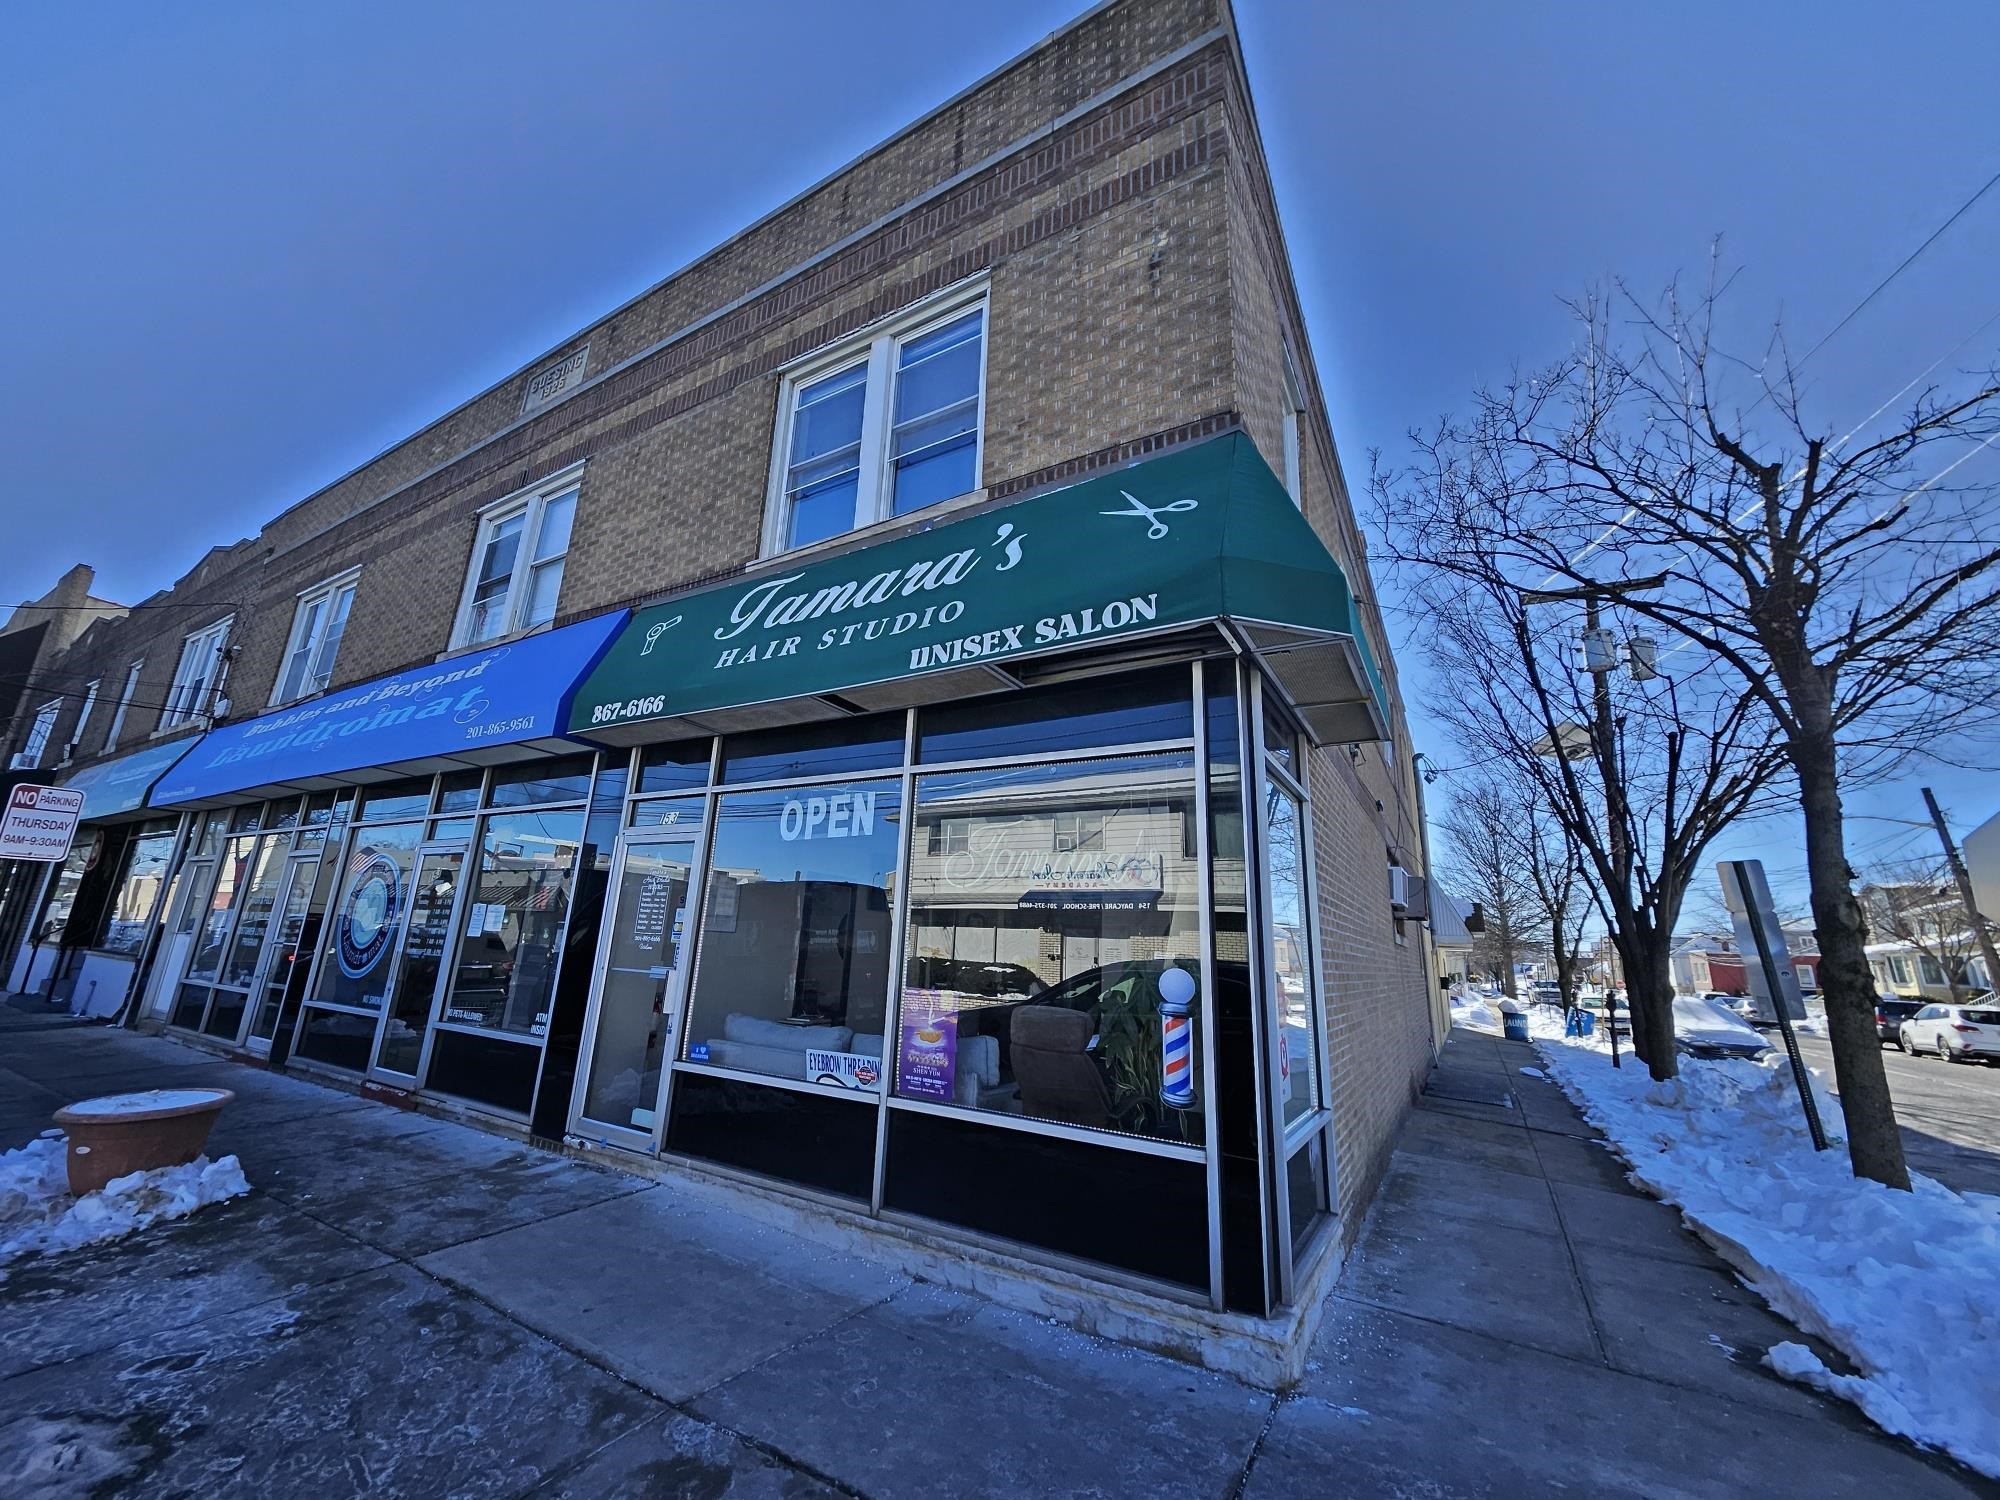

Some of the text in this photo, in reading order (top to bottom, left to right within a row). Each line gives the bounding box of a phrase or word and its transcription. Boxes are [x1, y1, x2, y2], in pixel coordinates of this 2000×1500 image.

[714, 523, 1028, 640] Tamara's
[714, 600, 965, 670] HAIR STUDIO
[909, 593, 1158, 670] UNISEX SALON
[242, 659, 492, 738] Bubbles and Beyond
[591, 694, 666, 723] 867-6166
[204, 685, 485, 769] Laundromat
[465, 716, 535, 739] 201-865-9561
[15, 790, 79, 807] NO PARKING
[11, 816, 72, 831] THURSDAY
[660, 811, 679, 825] 153
[780, 792, 876, 841] OPEN
[3, 834, 66, 847] 9AM-9:30AM
[453, 1009, 463, 1018] PETS
[463, 1011, 483, 1021] ALLOWED
[535, 1013, 547, 1022] ATM
[530, 1024, 545, 1034] INSID
[809, 1052, 841, 1073] EYEBROW
[929, 1069, 941, 1077] YUN
